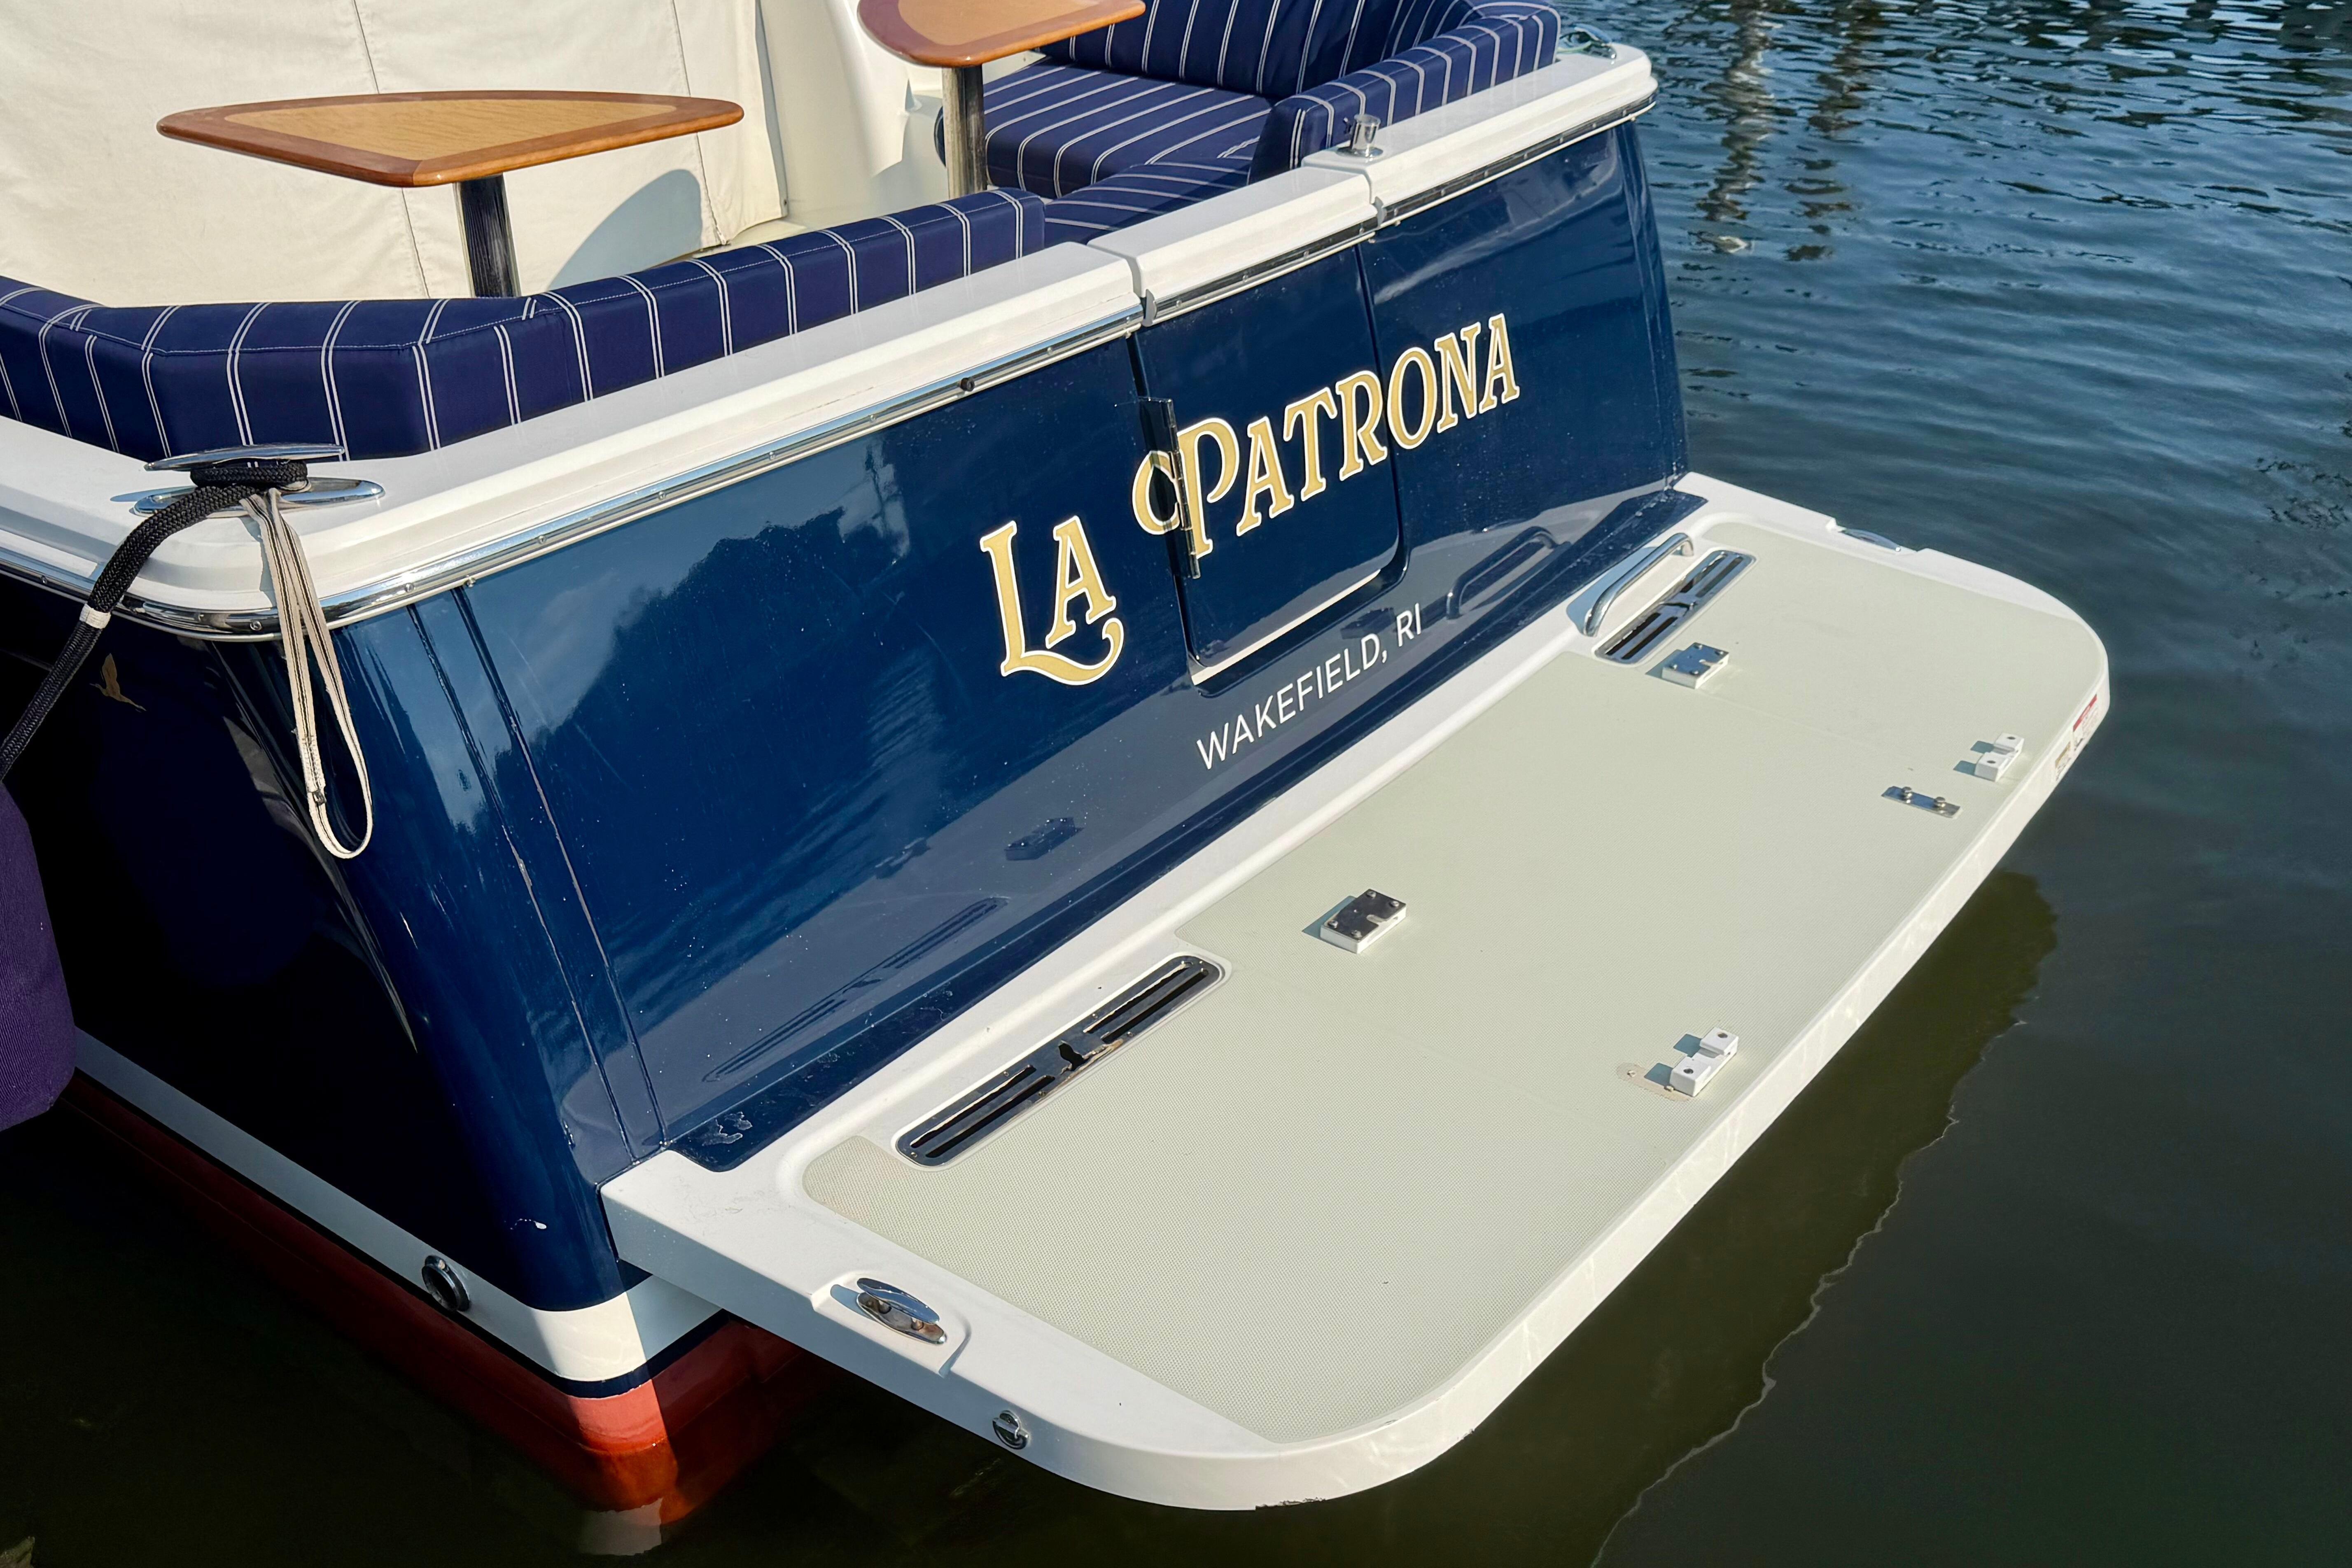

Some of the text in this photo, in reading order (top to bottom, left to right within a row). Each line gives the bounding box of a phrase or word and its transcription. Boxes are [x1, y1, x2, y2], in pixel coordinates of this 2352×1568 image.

[980, 313, 1520, 686] LA PATRONA
[1196, 603, 1421, 770] WAKEFIELD, RI
